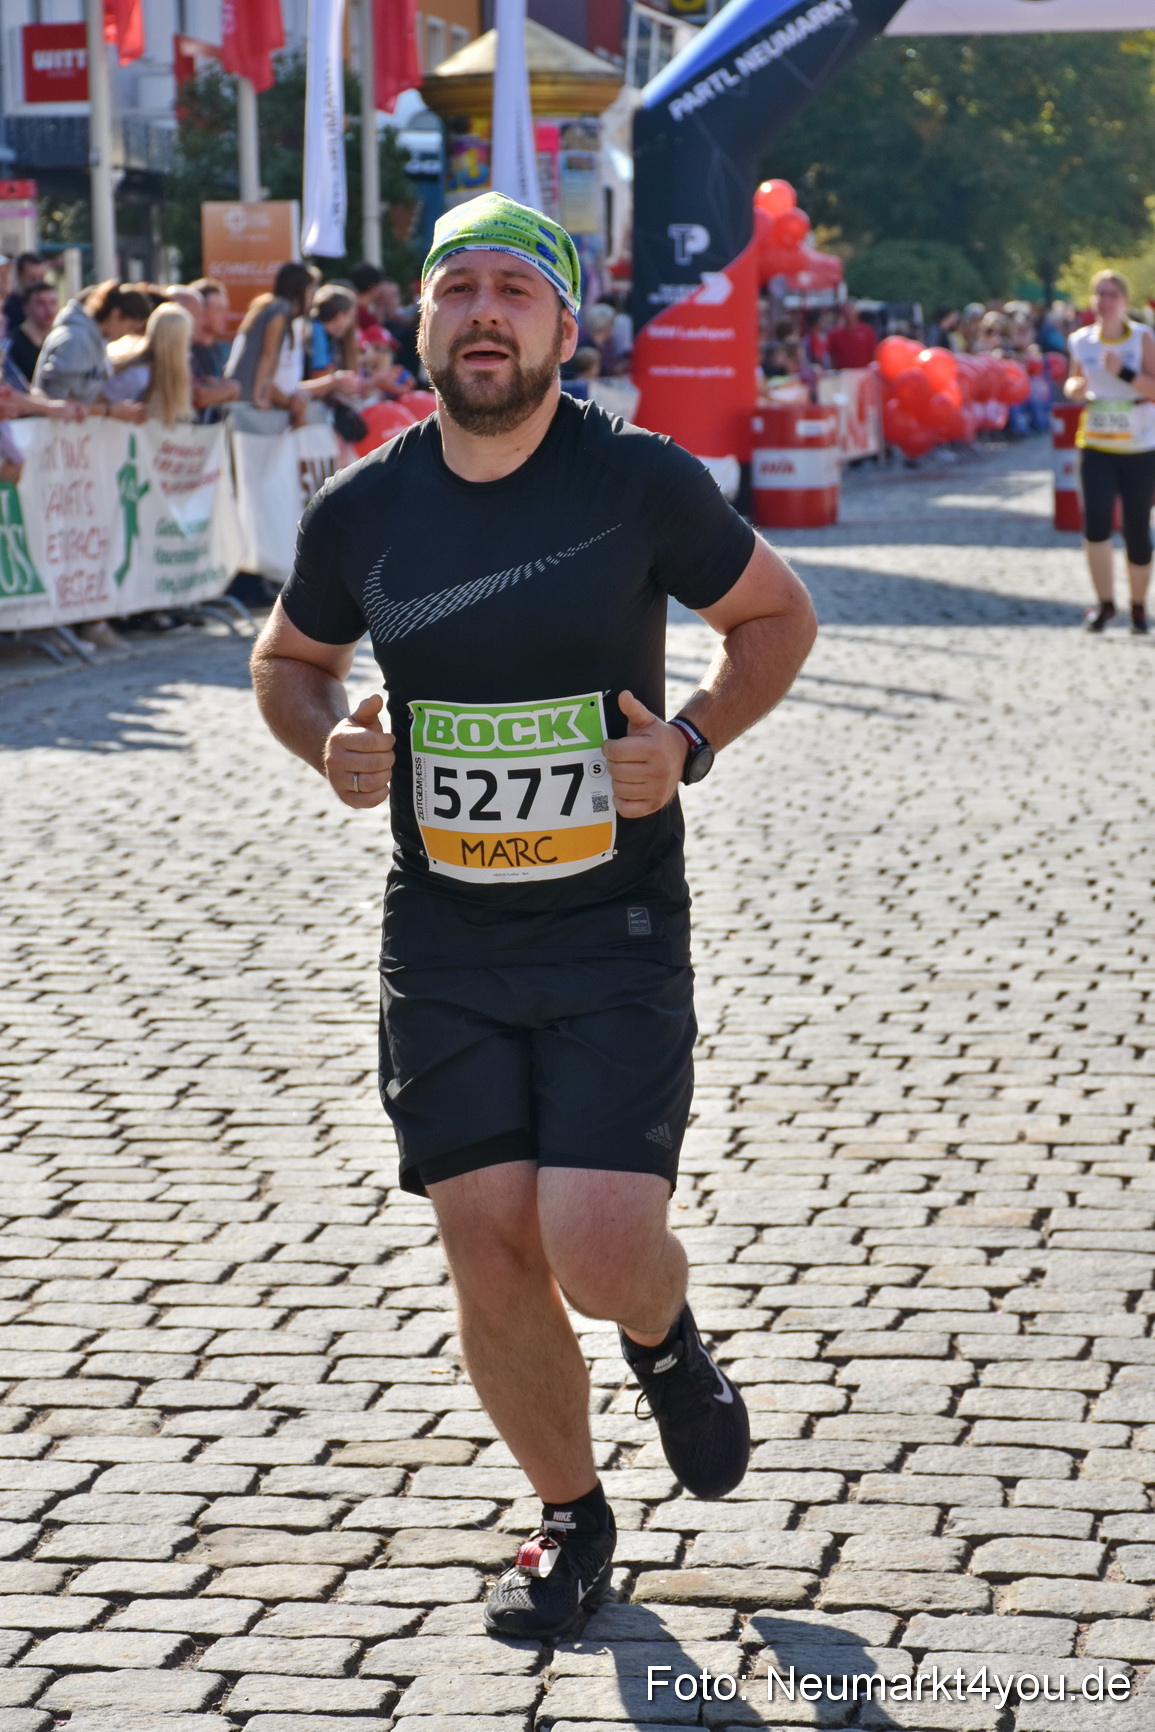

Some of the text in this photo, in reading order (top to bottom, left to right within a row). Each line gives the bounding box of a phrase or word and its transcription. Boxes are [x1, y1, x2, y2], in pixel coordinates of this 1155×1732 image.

[668, 67, 741, 121] PARTL
[424, 705, 586, 751] BOCK
[434, 763, 584, 821] 5277
[461, 836, 558, 867] MARC
[553, 1511, 573, 1521] NIKE
